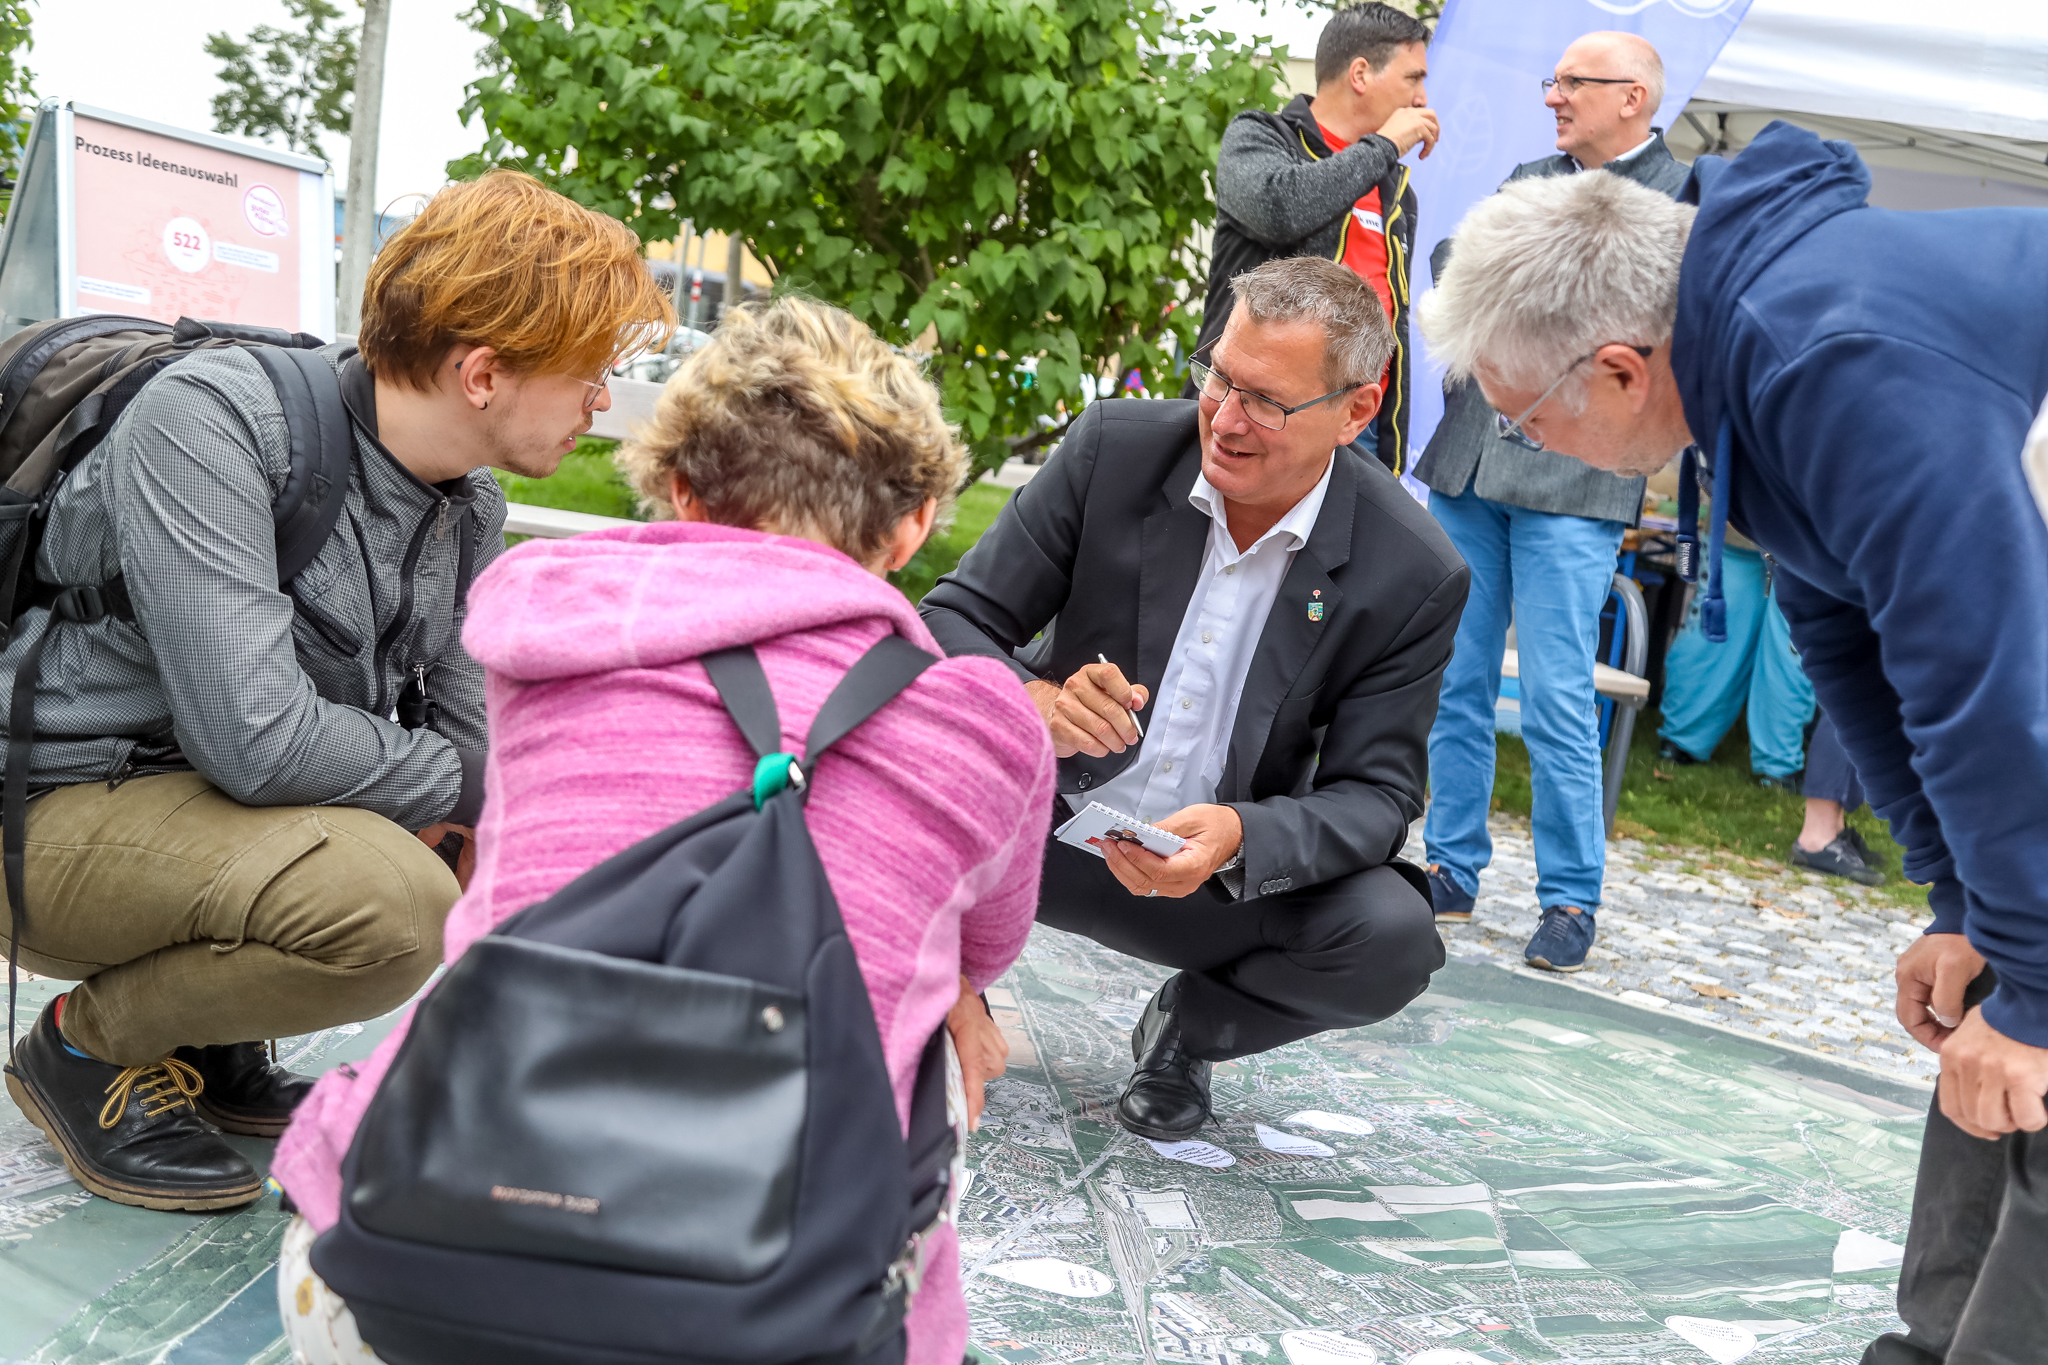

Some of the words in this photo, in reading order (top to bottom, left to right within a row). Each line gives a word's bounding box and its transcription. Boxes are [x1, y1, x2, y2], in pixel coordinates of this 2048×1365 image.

[75, 136, 133, 163] Prozess
[137, 151, 238, 188] Ideenauswahl
[174, 232, 201, 251] 522
[1030, 1336, 1123, 1354] Hopfengasse
